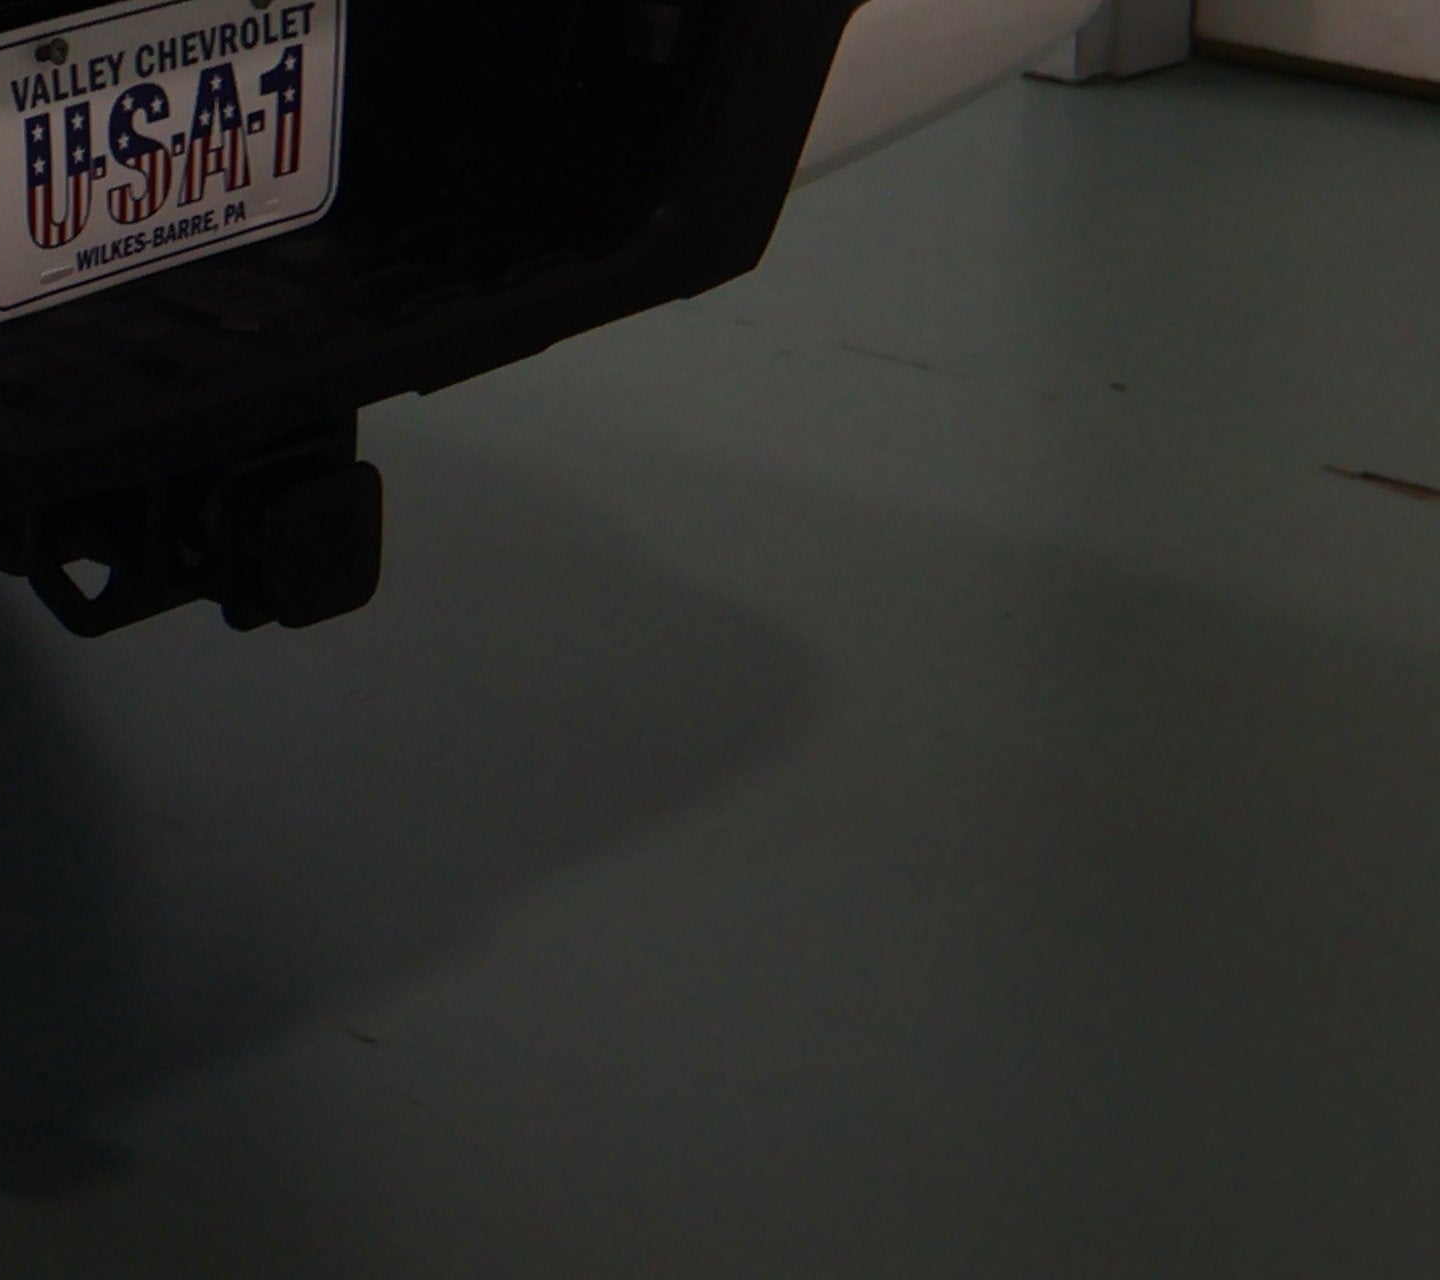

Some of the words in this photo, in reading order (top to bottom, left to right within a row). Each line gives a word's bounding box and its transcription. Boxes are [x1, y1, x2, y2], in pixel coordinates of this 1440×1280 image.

[11, 51, 126, 114] VALLEY
[135, 1, 317, 79] CHEVROLET
[76, 210, 220, 273] WILKES-BARRE,
[224, 201, 248, 226] PA
